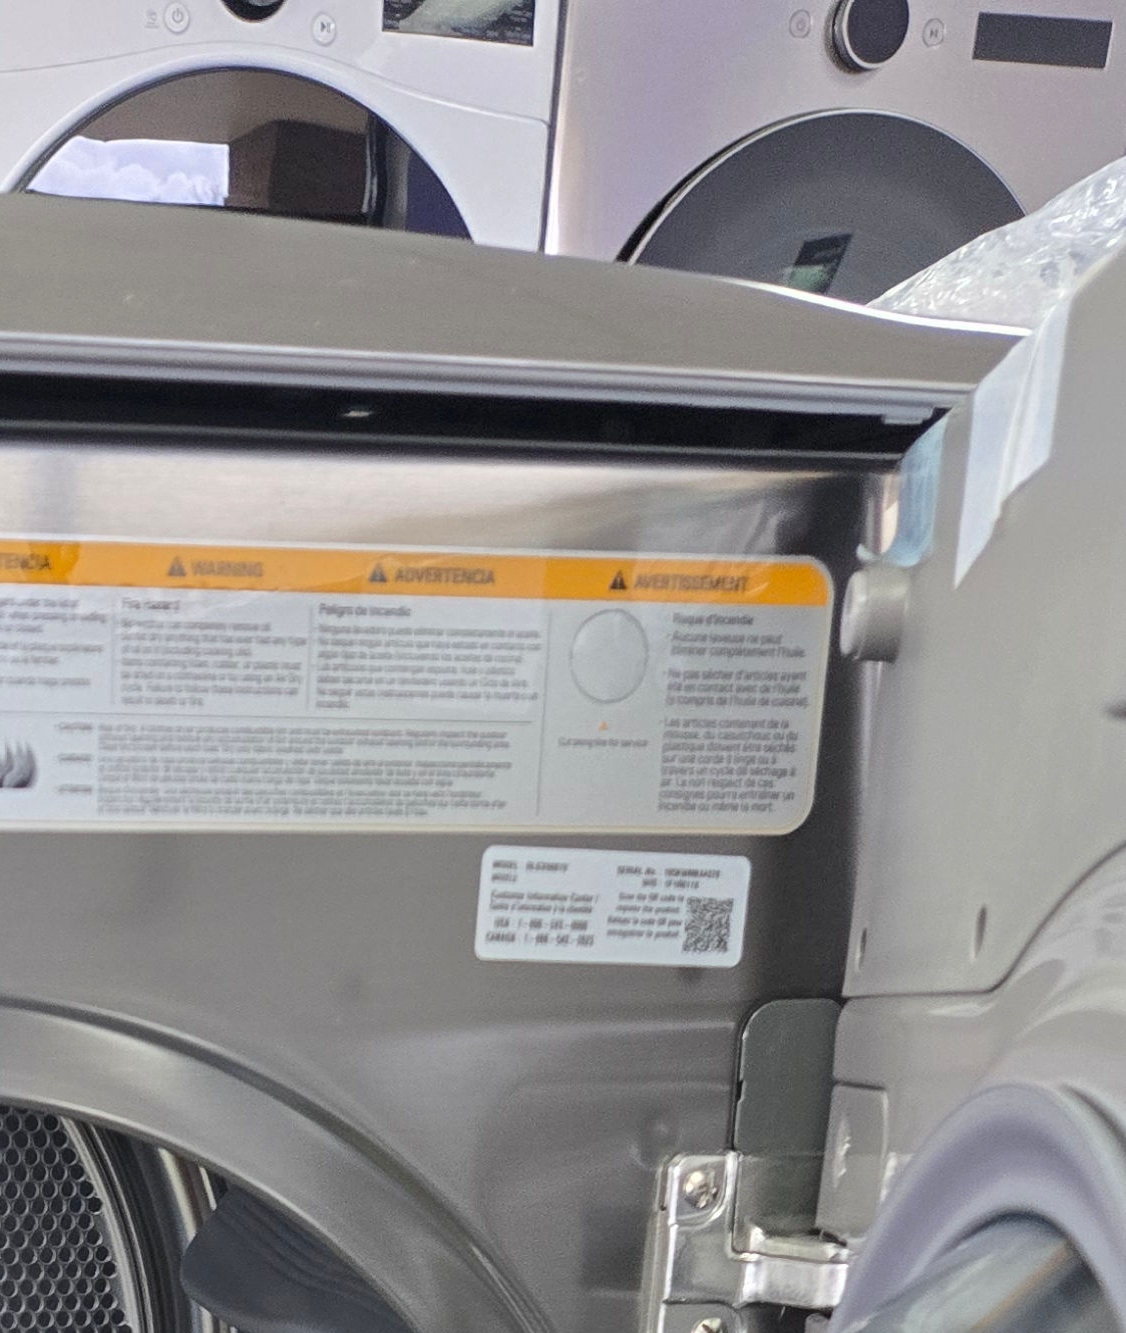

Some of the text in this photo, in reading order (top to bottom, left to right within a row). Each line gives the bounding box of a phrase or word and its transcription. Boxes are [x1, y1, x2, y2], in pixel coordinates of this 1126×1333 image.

[190, 561, 263, 577] WARNING
[395, 568, 495, 584] ADVERTENCIA
[634, 574, 749, 592] AVERTISSEMENT
